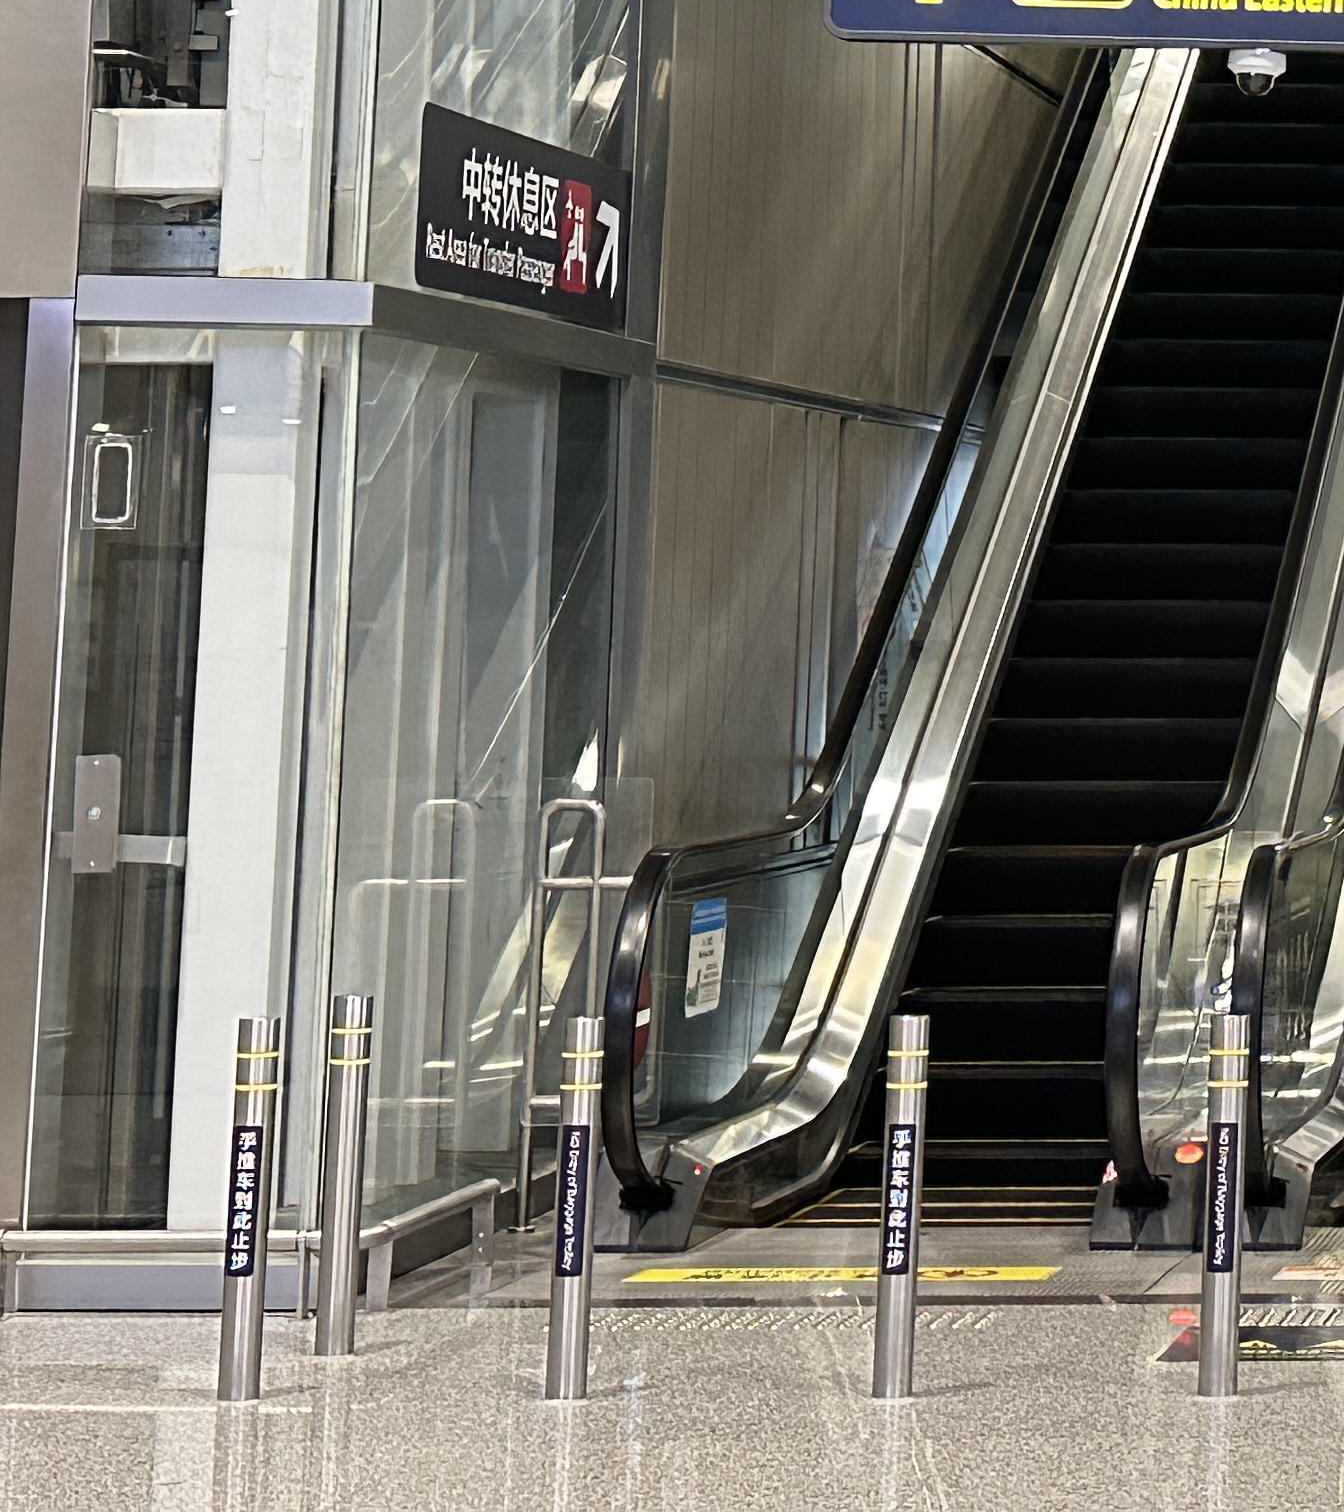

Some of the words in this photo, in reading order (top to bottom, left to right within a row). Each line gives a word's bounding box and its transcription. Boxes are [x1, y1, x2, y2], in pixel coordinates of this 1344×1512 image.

[462, 148, 560, 240] 中转休息区
